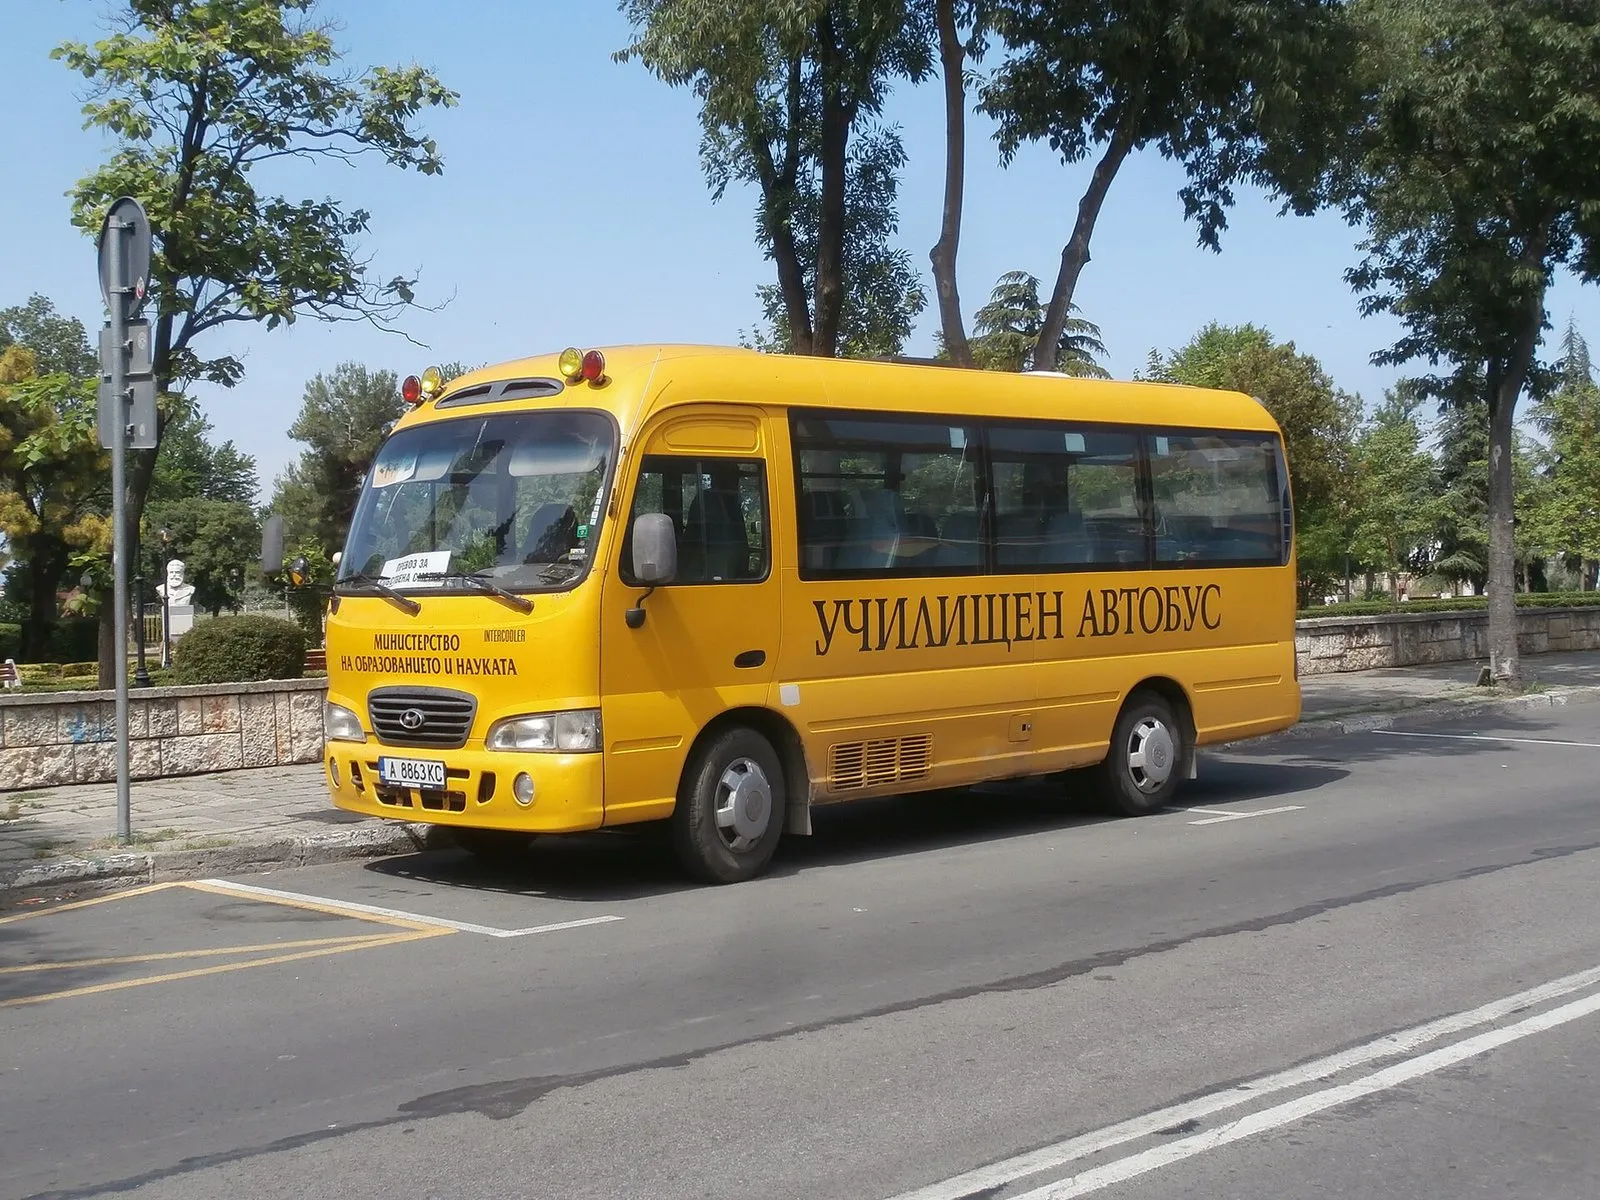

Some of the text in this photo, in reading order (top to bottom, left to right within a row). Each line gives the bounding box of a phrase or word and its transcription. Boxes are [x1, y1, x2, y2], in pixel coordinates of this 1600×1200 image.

[418, 558, 429, 569] ЗА
[813, 584, 1222, 656] УЧИЛИЩЕН АВТОБУС
[374, 634, 460, 651] МИНИСТЕРСТВО
[483, 629, 526, 643] INTERCOOLER
[341, 656, 353, 671] НА
[355, 656, 441, 674] ОБРАЗОВАНИЕТО
[456, 658, 517, 676] НАУКАТА
